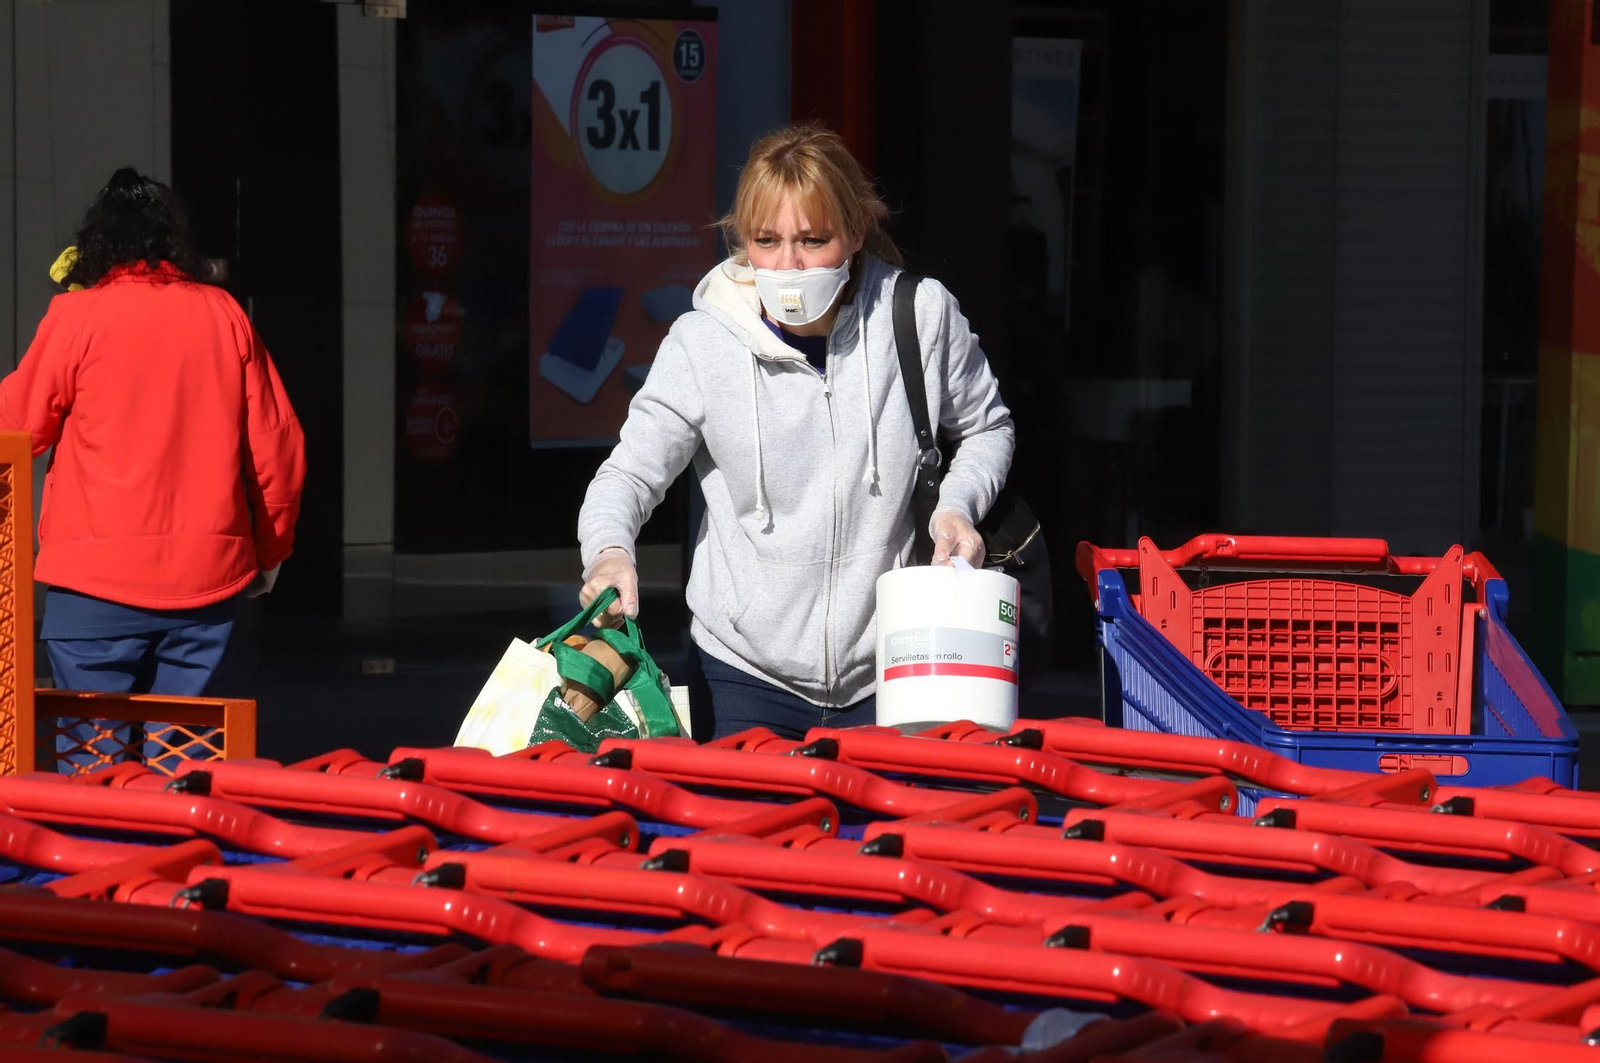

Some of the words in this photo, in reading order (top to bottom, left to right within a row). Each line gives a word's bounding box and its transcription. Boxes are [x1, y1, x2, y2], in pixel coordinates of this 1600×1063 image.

[679, 42, 700, 67] 15
[587, 79, 661, 151] 3x1
[588, 221, 625, 232] COMPRA
[428, 244, 447, 267] 36
[890, 631, 937, 647] Carrefou
[1004, 643, 1011, 656] 2
[891, 652, 930, 665] Servilletas
[943, 652, 963, 661] rollo
